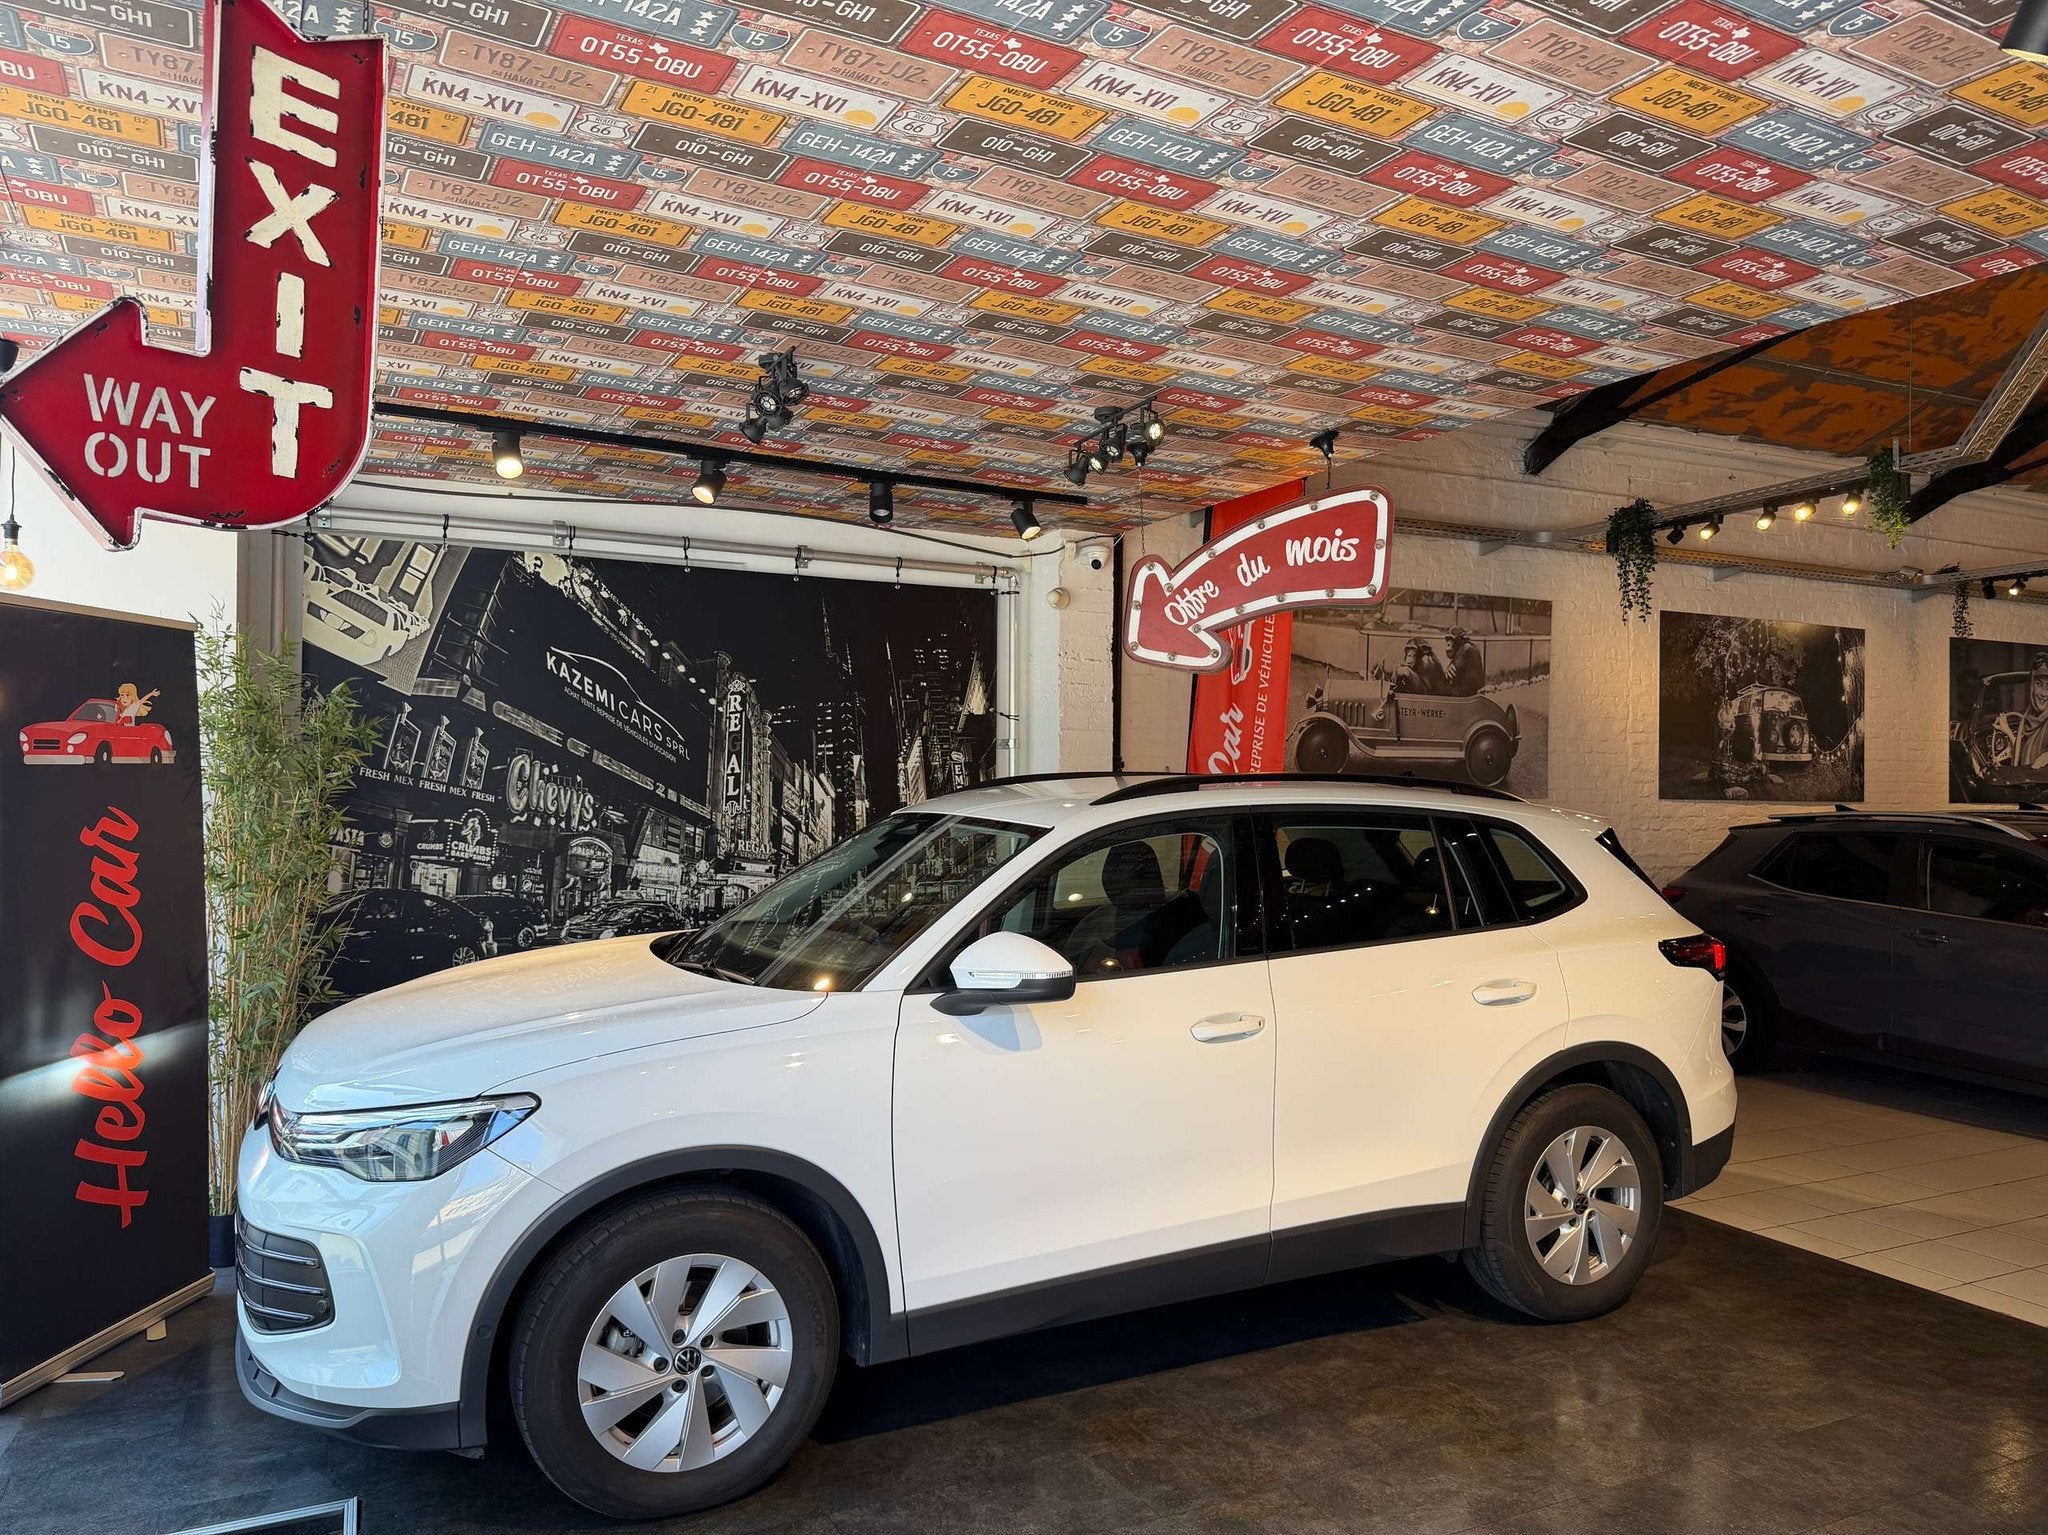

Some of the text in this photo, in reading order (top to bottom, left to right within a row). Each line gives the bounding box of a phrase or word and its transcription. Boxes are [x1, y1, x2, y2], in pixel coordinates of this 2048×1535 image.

[971, 28, 1004, 40] TEXAS
[1335, 23, 1368, 36] TEXAS
[1466, 20, 1499, 35] 15
[1706, 18, 1740, 30] TEXAS
[1836, 15, 1874, 30] 15
[46, 34, 71, 48] 15
[394, 31, 415, 45] 15
[614, 34, 646, 45] TEXAS
[745, 32, 769, 46] 15
[1102, 27, 1130, 42] 15
[669, 90, 752, 113] NEW YORK
[1000, 85, 1079, 109] NEW YORK
[1336, 82, 1412, 106] NEW YORK
[1679, 78, 1750, 102] NEW YORK
[25, 93, 119, 116] NEW YORK
[1871, 107, 1904, 121] 66
[590, 123, 612, 136] 66
[902, 120, 926, 134] 66
[1219, 118, 1246, 132] 66
[1543, 113, 1573, 127] 66
[792, 132, 900, 165] GEH-142A
[1103, 129, 1206, 163] GEH-142A
[1419, 124, 1518, 159] GEH-142A
[1741, 120, 1834, 155] GEH-142A
[487, 133, 599, 166] GEH-142A
[1237, 167, 1261, 177] 15
[1842, 158, 1873, 168] 15
[78, 173, 98, 182] 15
[530, 232, 548, 241] 66
[1323, 230, 1346, 240] 66
[1490, 234, 1572, 258] GEH-142A
[445, 240, 540, 264] GEH-142A
[701, 239, 792, 262] GEH-142A
[960, 238, 1048, 262] GEH-142A
[1223, 237, 1308, 262] GEH-142A
[239, 46, 341, 478] EXIT
[83, 373, 216, 438] WAY
[84, 432, 210, 488] OUT
[1164, 528, 1360, 626] Offre du mois
[547, 652, 690, 760] KAZEMI CARS SPRL
[580, 696, 596, 712] VENTE
[1256, 694, 1267, 714] DE
[726, 693, 742, 796] REGAL
[360, 767, 390, 782] FRESH
[394, 775, 414, 786] MEX
[419, 780, 446, 792] FRESH
[450, 786, 468, 797] MEX
[471, 791, 495, 802] FRESH
[506, 754, 594, 831] Chevys
[451, 841, 492, 856] CRUMBS
[69, 806, 149, 1229] Hello Car
